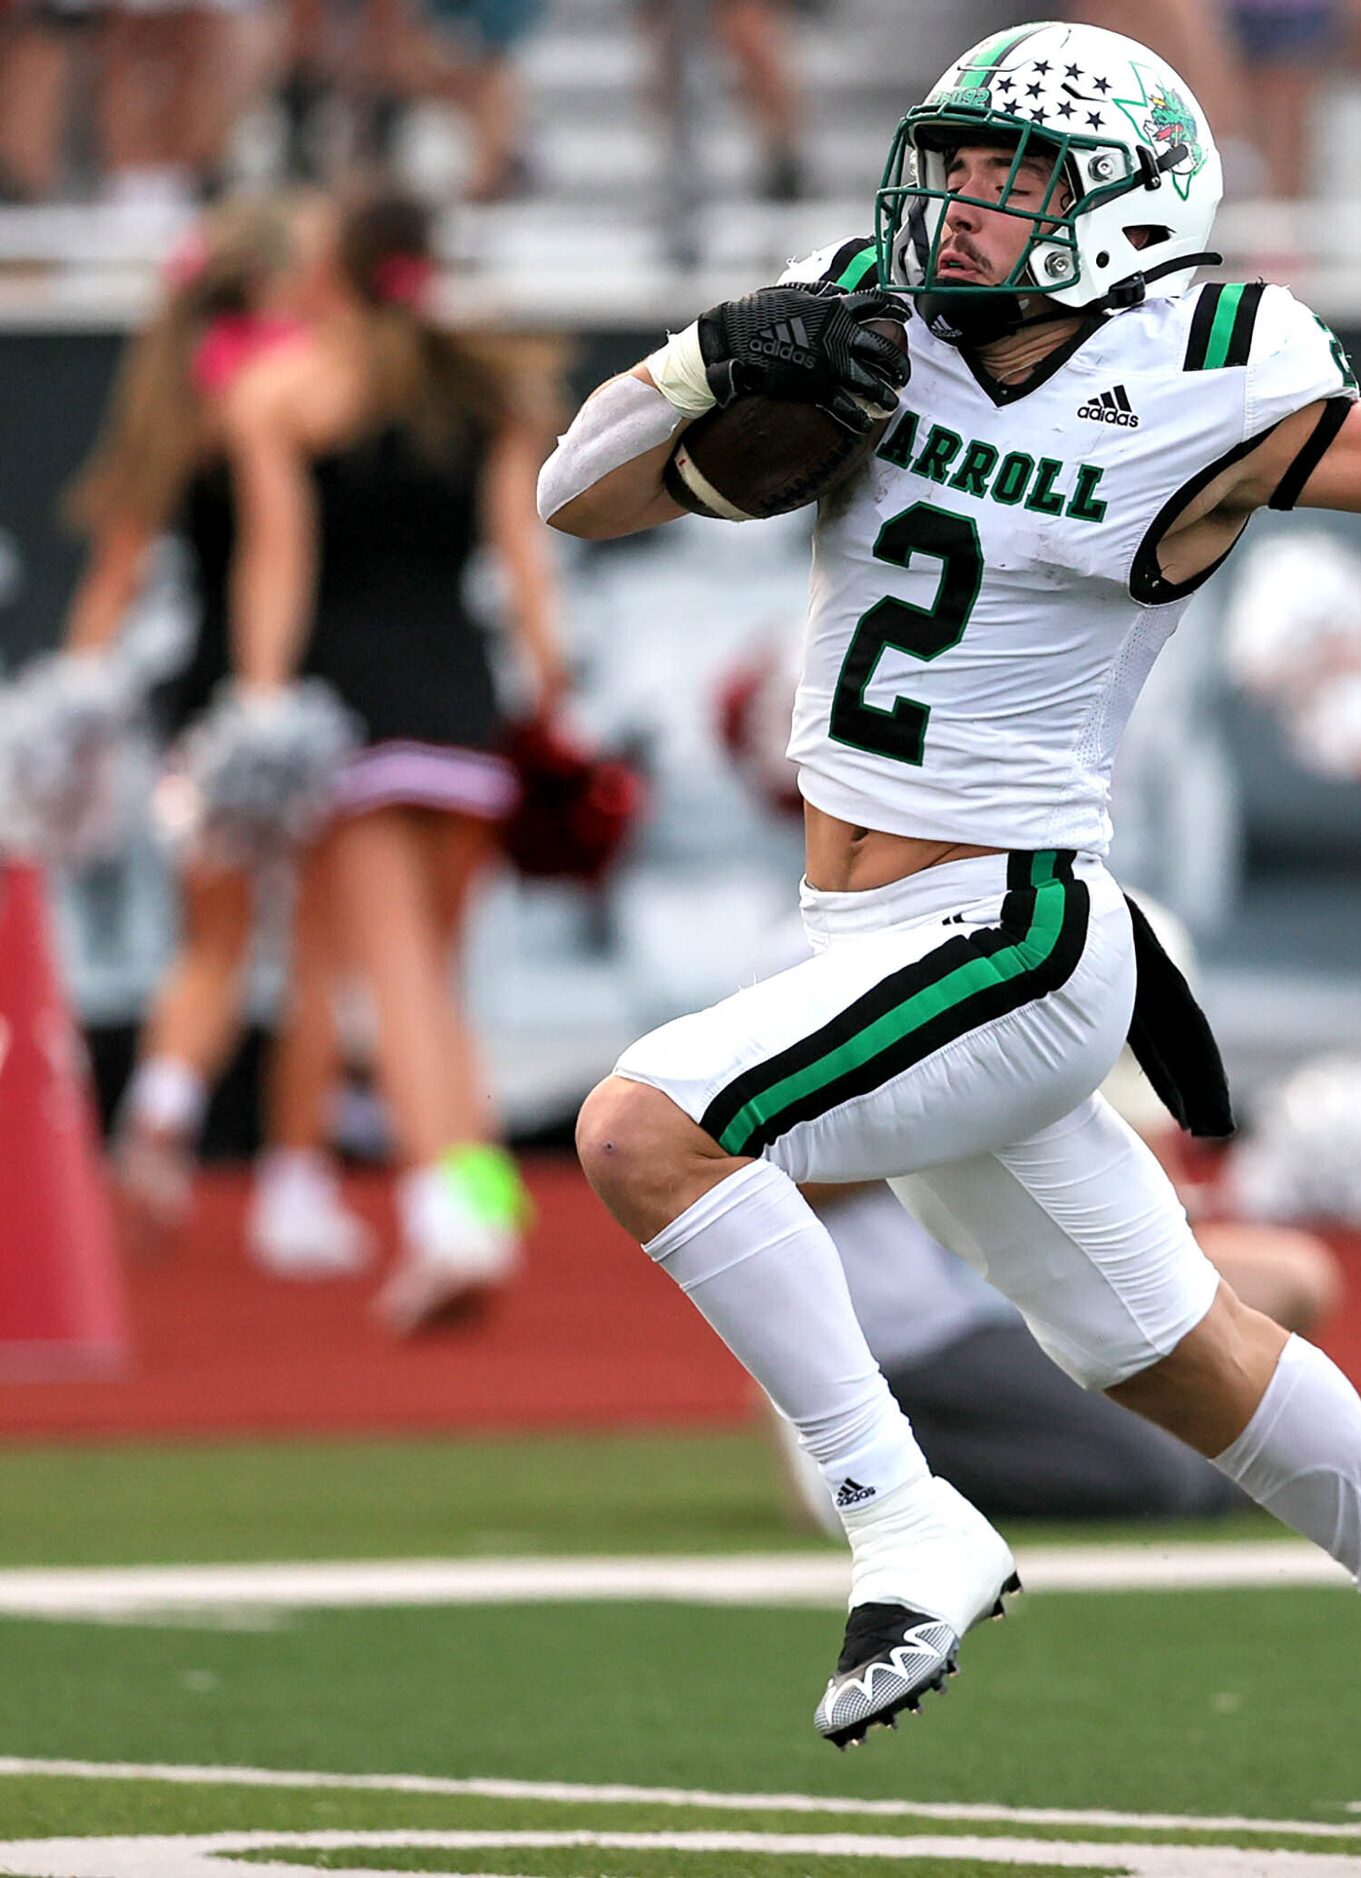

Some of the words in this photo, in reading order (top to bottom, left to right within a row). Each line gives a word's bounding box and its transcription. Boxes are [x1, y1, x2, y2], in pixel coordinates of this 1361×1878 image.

[750, 337, 817, 369] adidas
[1077, 405, 1139, 428] adidas
[876, 410, 1108, 523] ARROLL
[829, 500, 984, 766] 2
[836, 1486, 876, 1507] adidas
